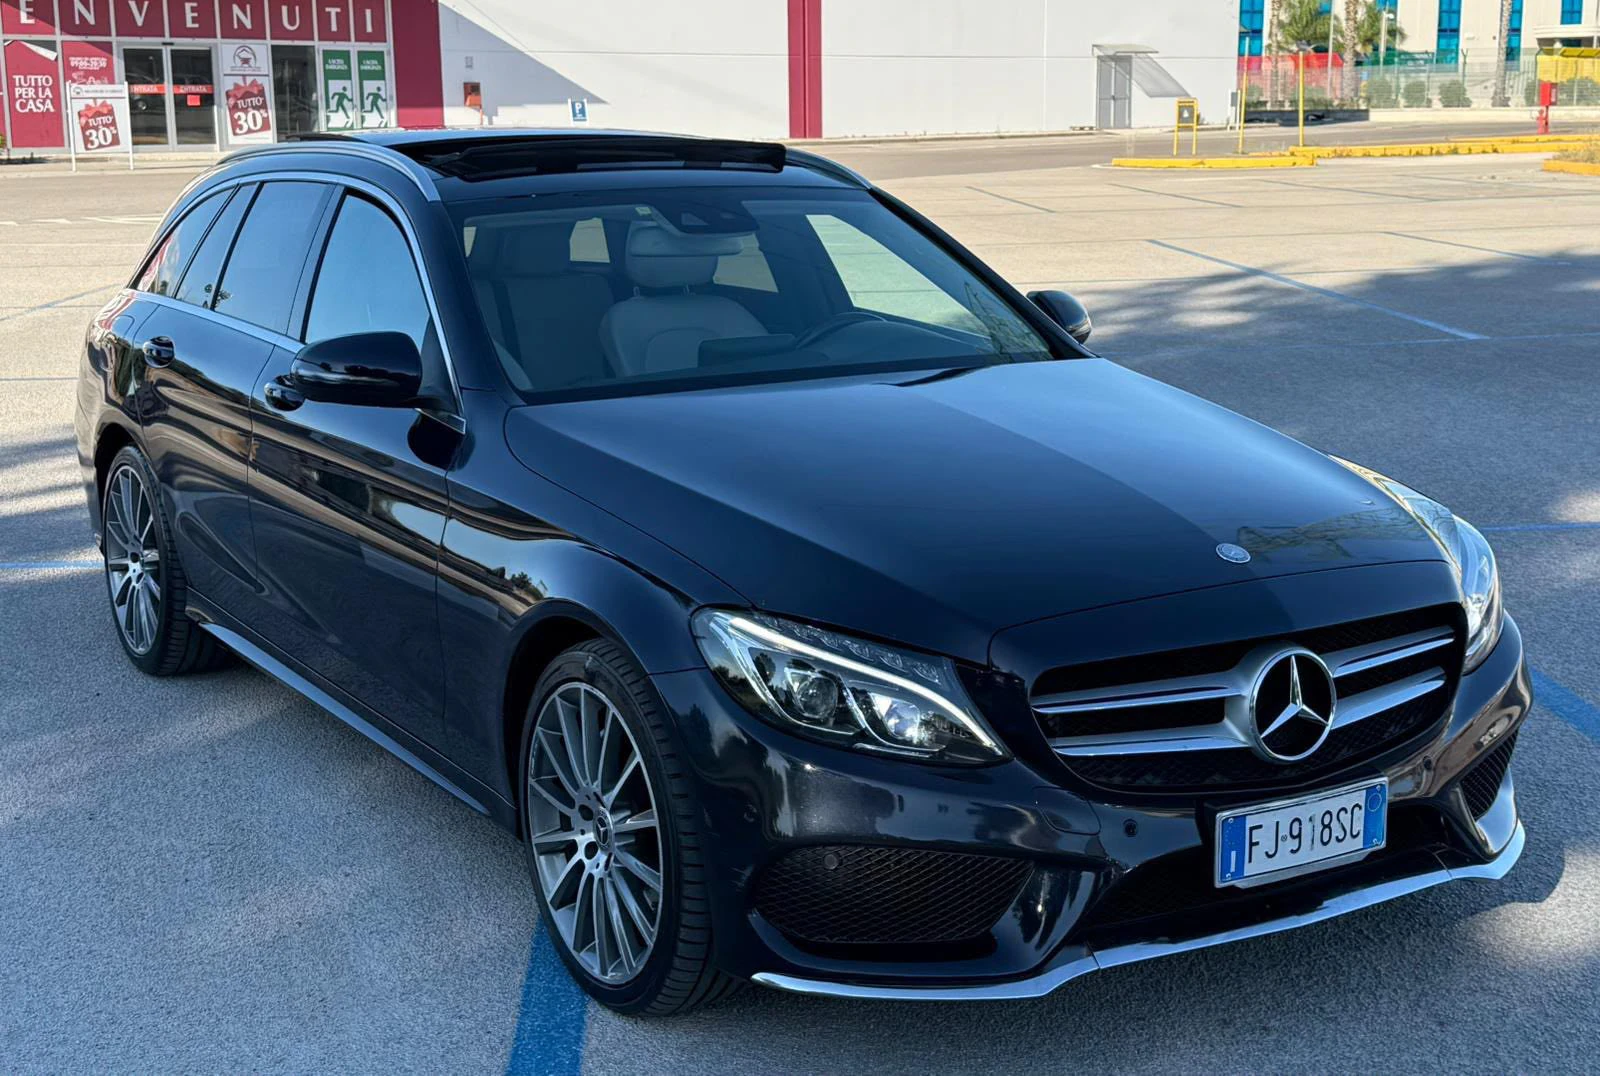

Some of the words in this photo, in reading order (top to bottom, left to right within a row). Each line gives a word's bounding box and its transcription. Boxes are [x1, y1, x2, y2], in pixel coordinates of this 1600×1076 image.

[12, 75, 53, 87] TUTTO
[15, 88, 36, 99] PER
[38, 88, 53, 99] LA
[15, 100, 55, 113] CASA
[575, 102, 582, 114] P
[1248, 803, 1362, 863] FJ918SC
